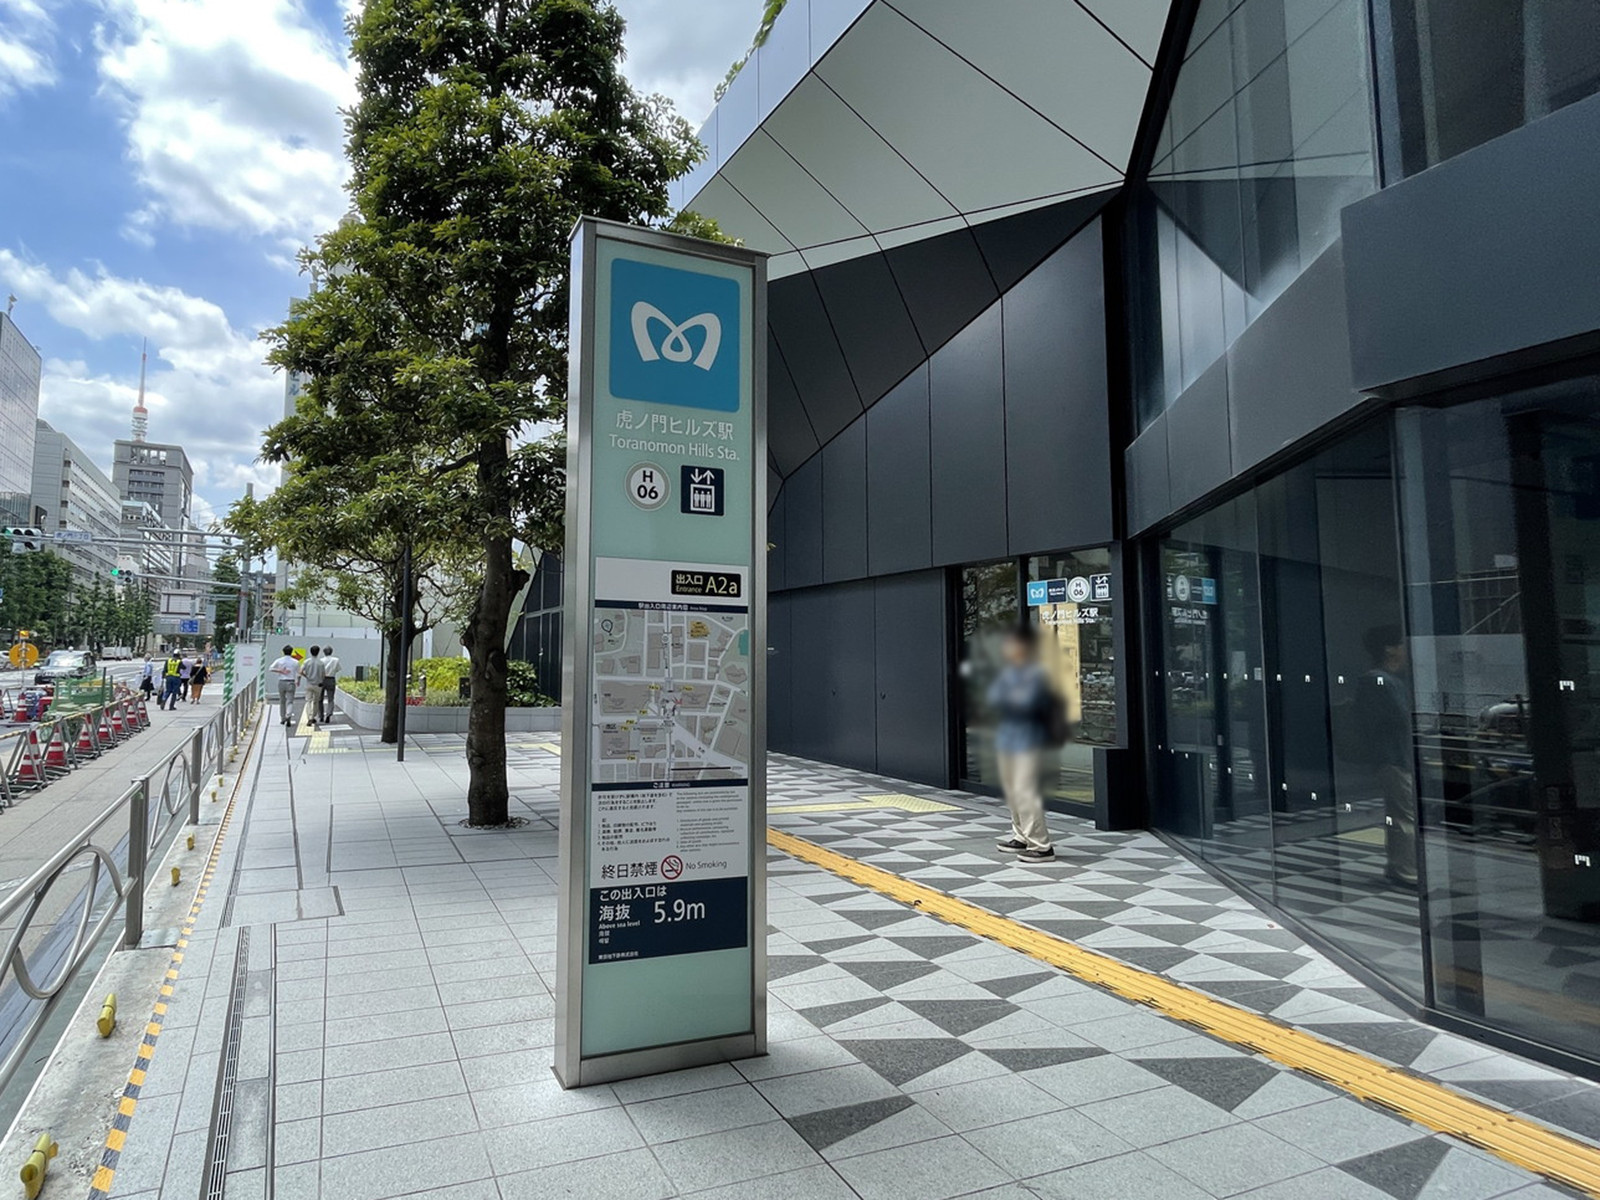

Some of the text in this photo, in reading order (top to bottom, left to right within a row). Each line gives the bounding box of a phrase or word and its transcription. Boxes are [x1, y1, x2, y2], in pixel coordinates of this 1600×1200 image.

[616, 410, 734, 441] 虎ノ門ヒルズ駅
[609, 434, 740, 461] Toranomon Hills Sta.
[642, 470, 653, 483] H
[637, 484, 658, 500] 06
[676, 574, 738, 595] 出入口 A2a
[676, 585, 703, 593] Entrance
[602, 861, 658, 880] 終日禁煙
[686, 861, 727, 870] No Smoking
[600, 886, 667, 901] この出入口は
[599, 899, 705, 924] 海抜 5.9m
